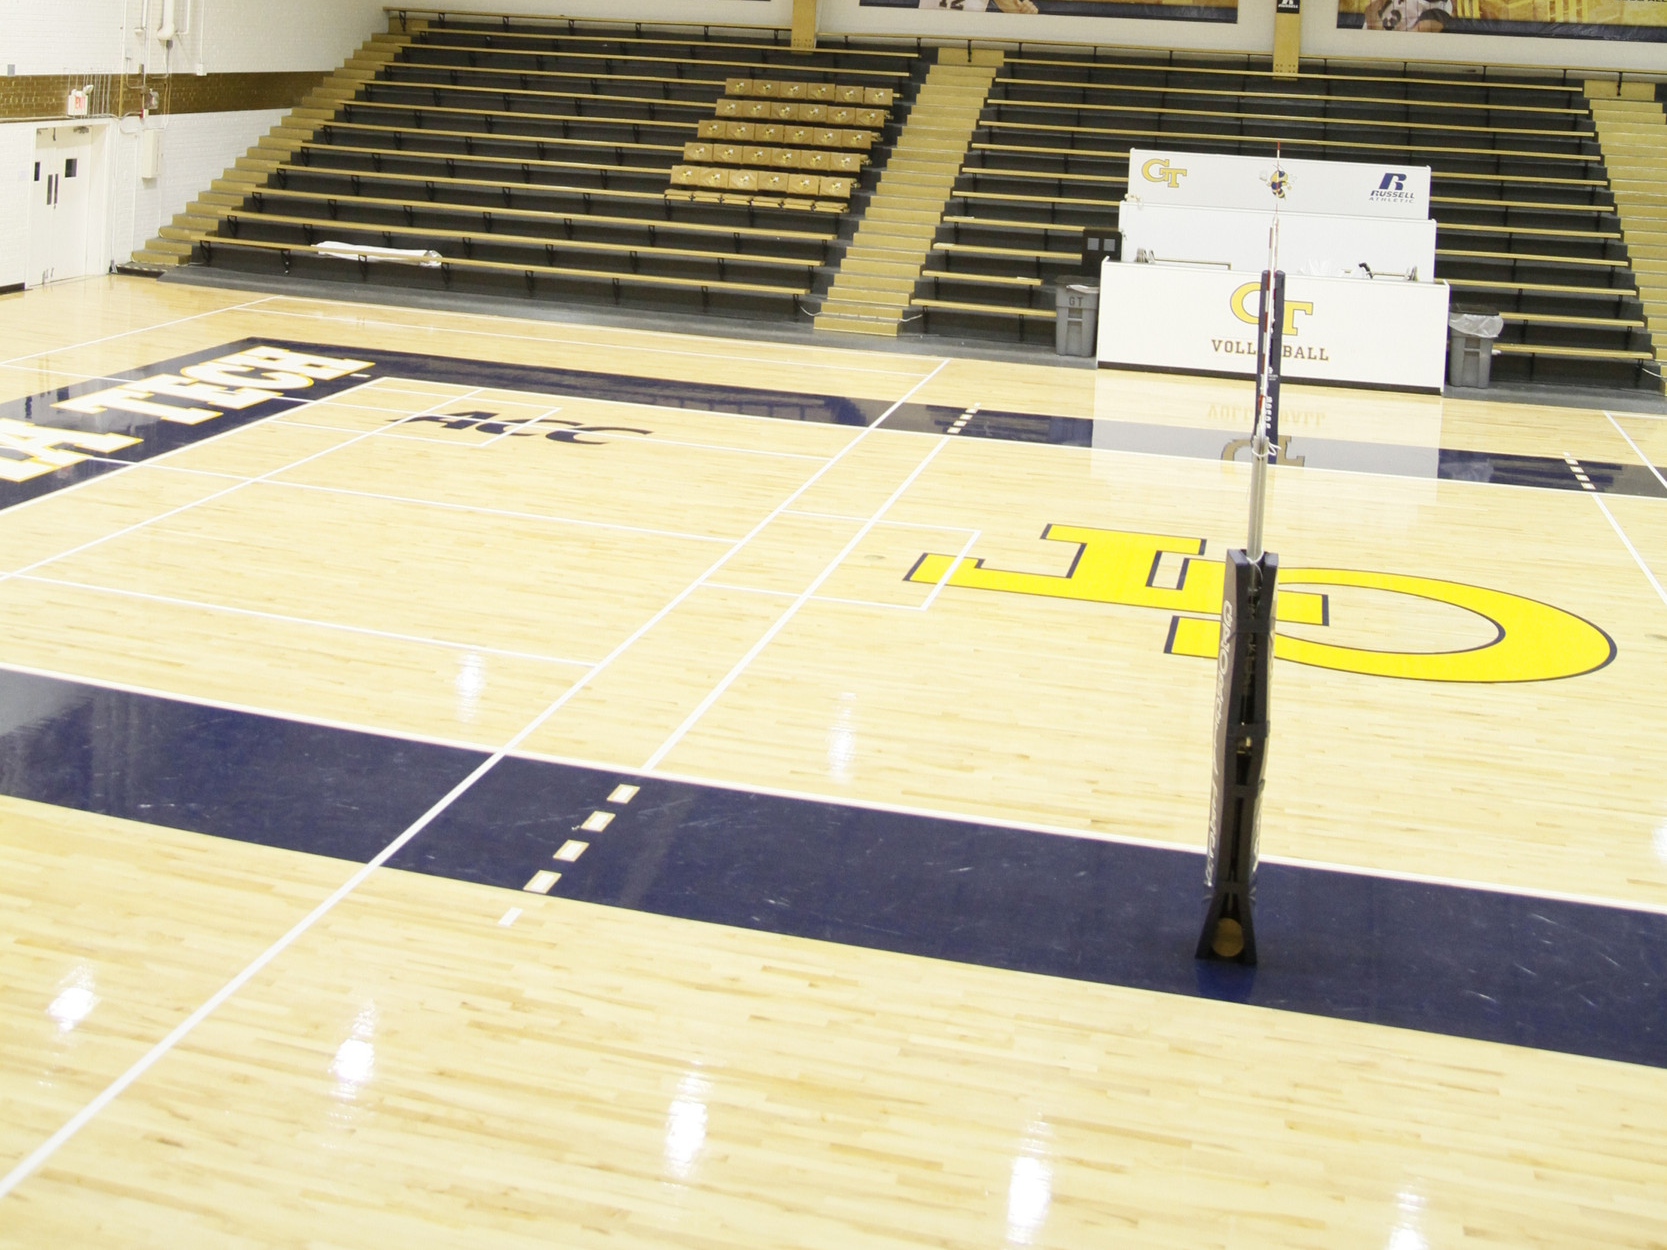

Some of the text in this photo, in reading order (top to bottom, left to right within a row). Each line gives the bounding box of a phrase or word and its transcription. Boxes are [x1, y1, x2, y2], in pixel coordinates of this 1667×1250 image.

[1141, 158, 1187, 188] GT
[1370, 190, 1416, 199] RUSSELL
[1068, 295, 1084, 308] GT
[1211, 338, 1330, 362] VOLLBALL
[50, 345, 376, 426] TECH
[384, 410, 655, 446] ACC
